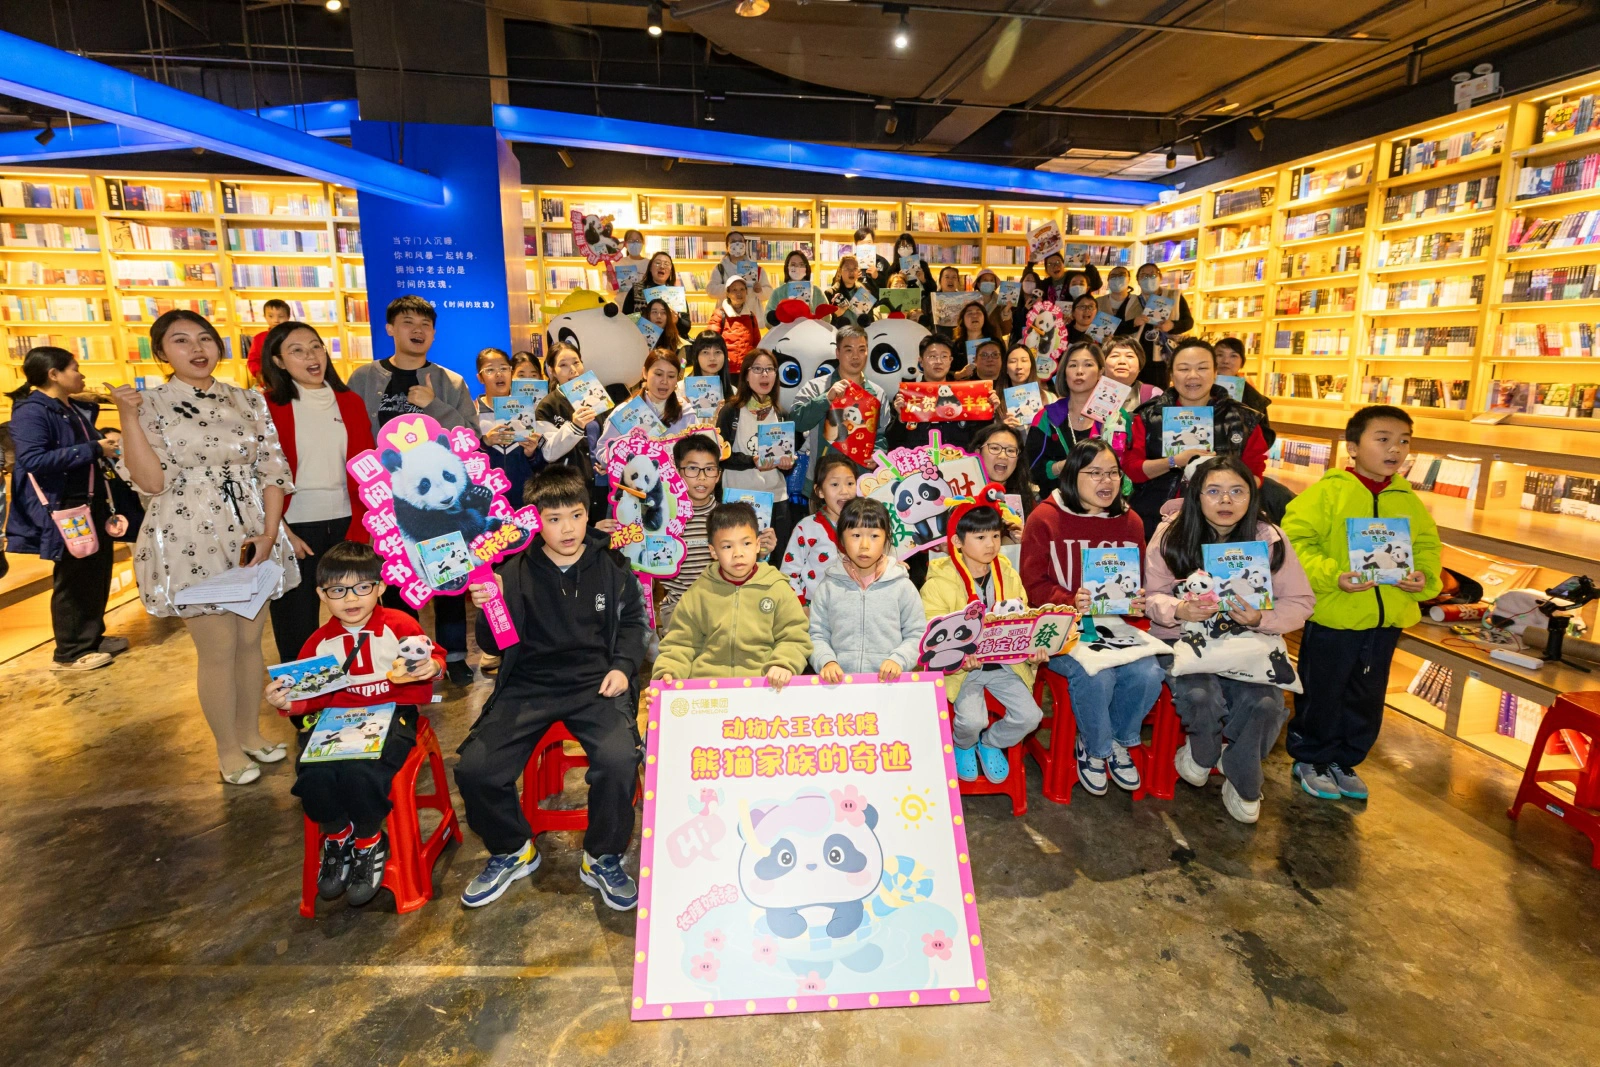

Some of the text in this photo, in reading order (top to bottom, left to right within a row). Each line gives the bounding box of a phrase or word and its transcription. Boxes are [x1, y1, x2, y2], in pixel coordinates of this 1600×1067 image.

[395, 265, 466, 275] 拥抱中老去的是
[905, 395, 938, 413] 庆贺
[961, 394, 991, 412] 丰年
[350, 453, 433, 607] 四阅新华书店
[976, 635, 1032, 655] 指定你
[691, 697, 729, 710] 长隆集团
[722, 712, 880, 741] 动物大王在长隆
[691, 740, 912, 781] 熊猫家族的奇迹
[676, 821, 711, 857] Hi
[676, 883, 740, 932] 长隆妹猪
